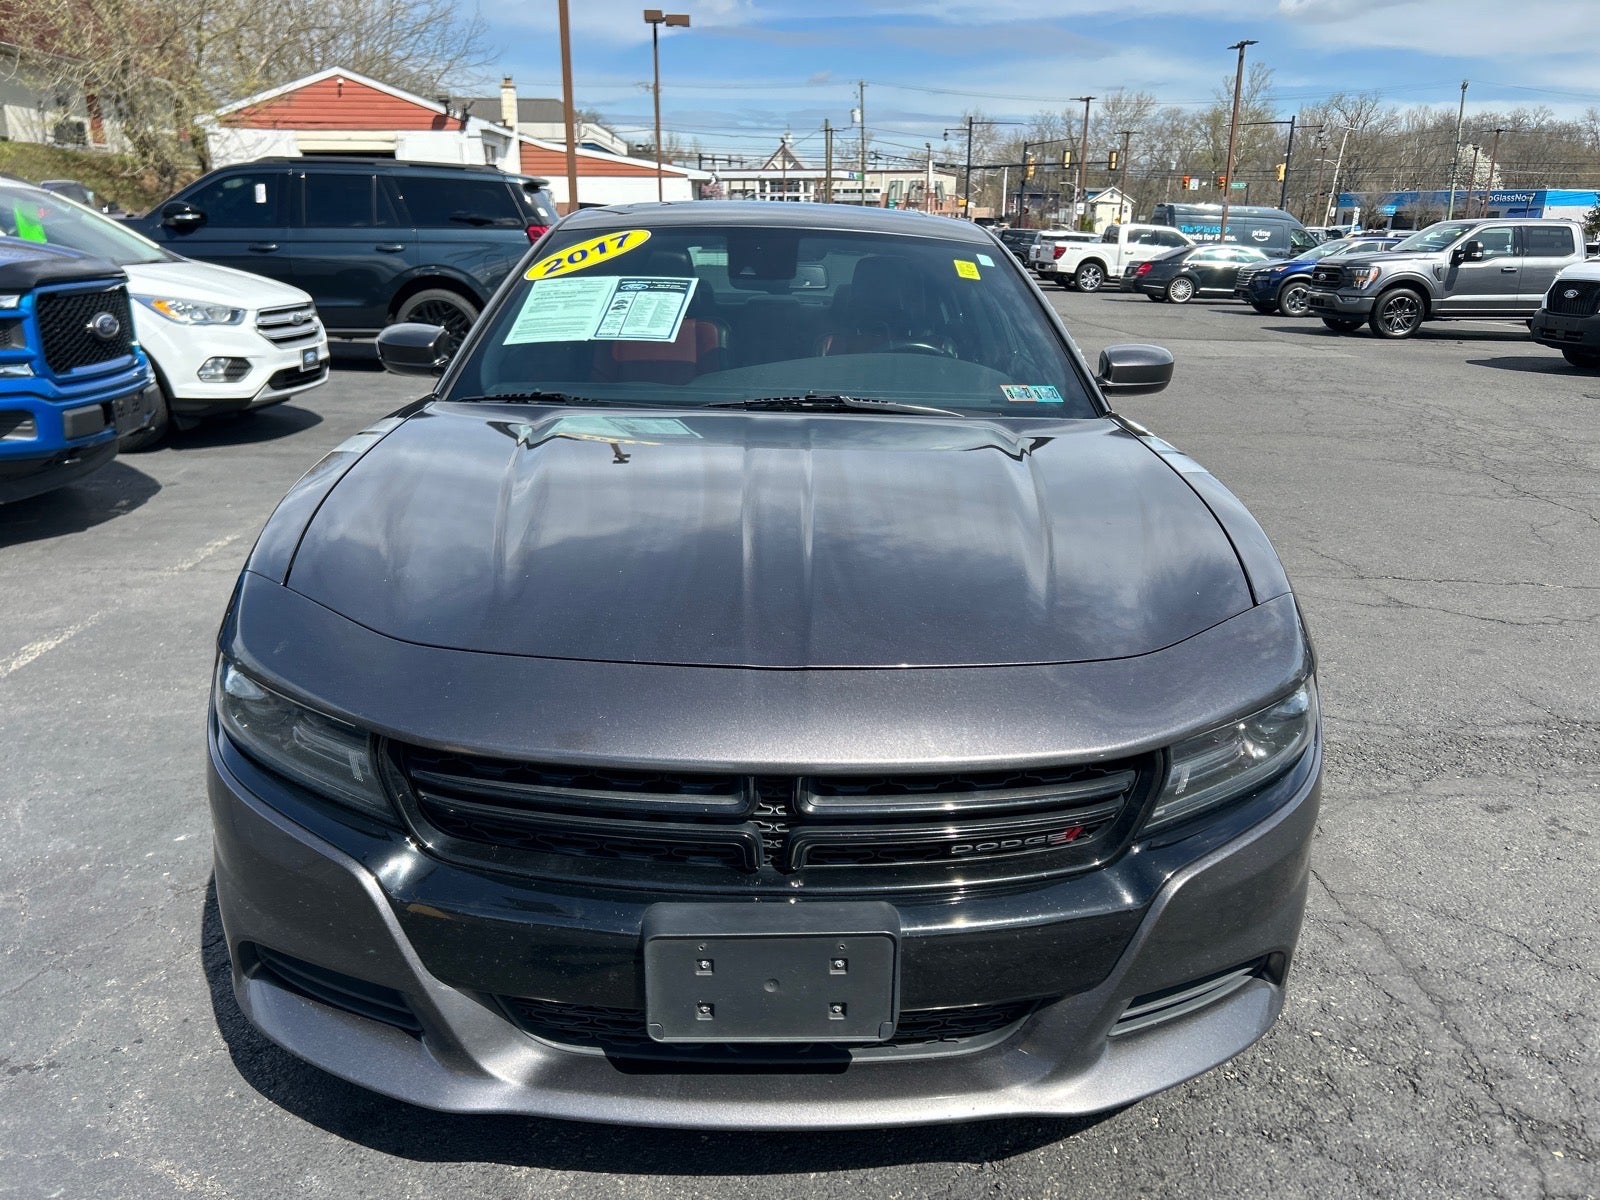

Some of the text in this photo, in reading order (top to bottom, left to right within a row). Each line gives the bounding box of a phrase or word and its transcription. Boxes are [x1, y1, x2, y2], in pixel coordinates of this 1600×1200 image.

[1211, 226, 1231, 234] ASP
[1252, 229, 1271, 237] prime
[1203, 233, 1214, 241] for
[1215, 234, 1238, 242] Pme.
[542, 232, 631, 276] 2017
[950, 832, 1068, 853] DODGE
